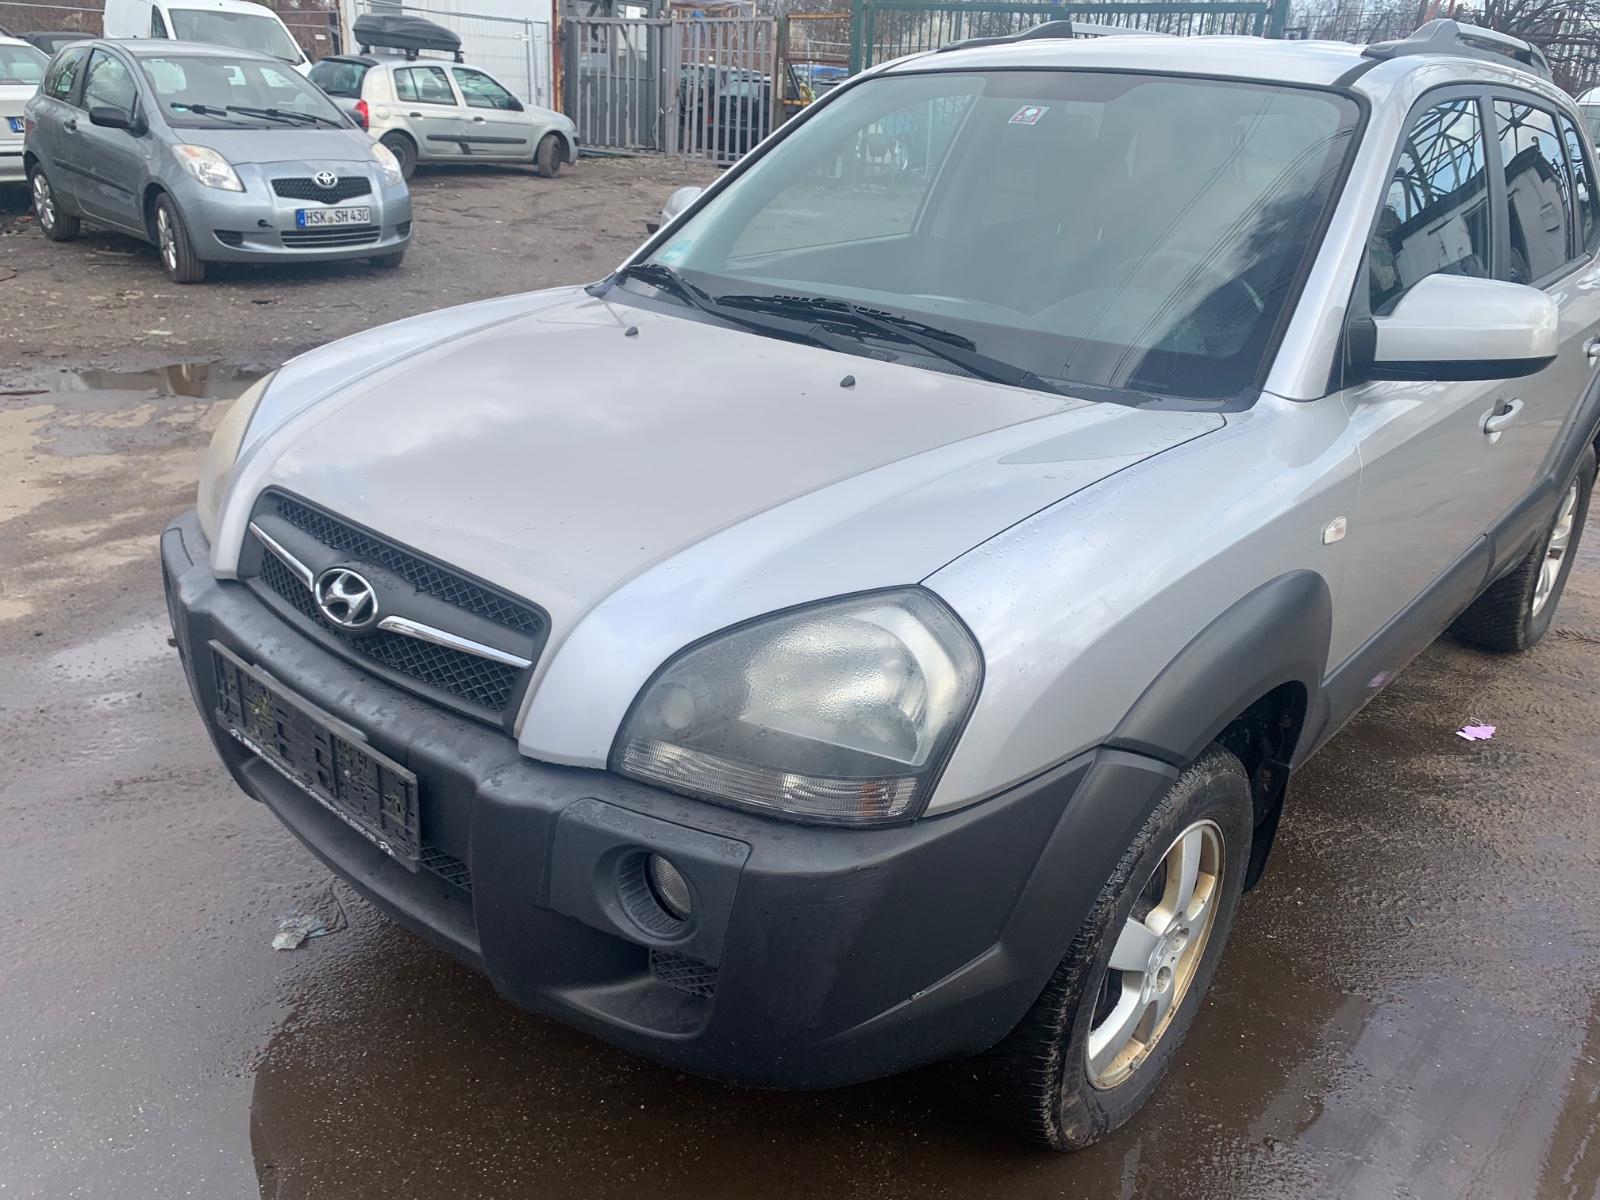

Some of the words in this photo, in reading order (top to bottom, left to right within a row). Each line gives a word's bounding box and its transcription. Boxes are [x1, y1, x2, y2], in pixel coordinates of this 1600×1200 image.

[305, 211, 327, 224] HSK
[334, 210, 348, 223] SH
[350, 209, 368, 222] 430
